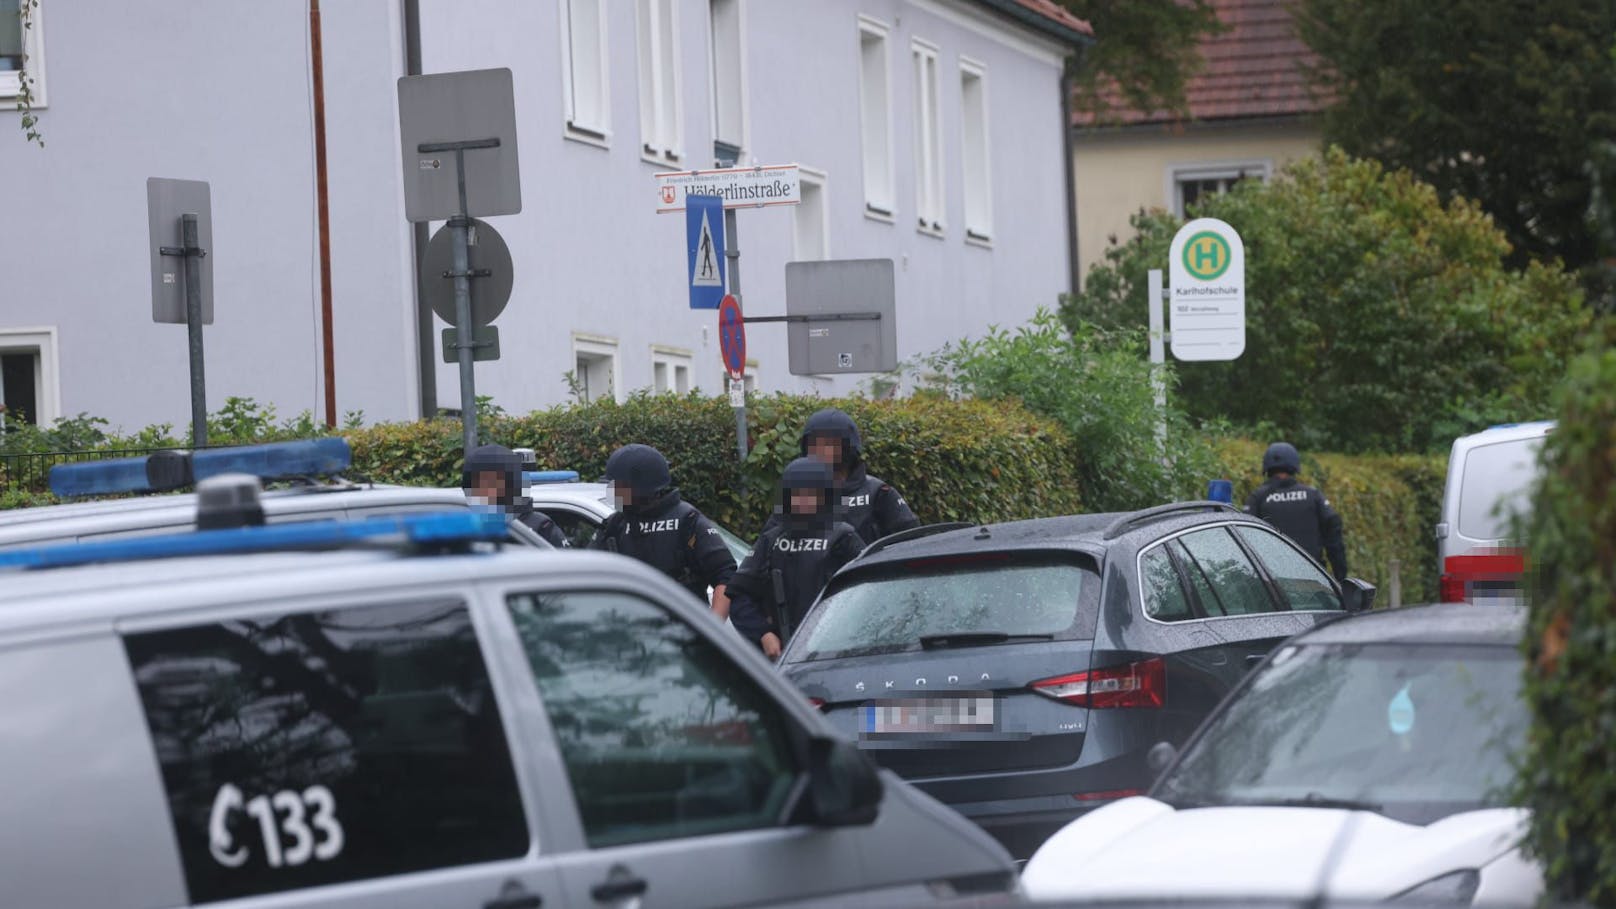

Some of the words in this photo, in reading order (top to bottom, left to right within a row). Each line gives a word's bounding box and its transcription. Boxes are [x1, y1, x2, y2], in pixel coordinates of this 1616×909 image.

[684, 180, 791, 201] Hölderlinstraße
[1176, 286, 1239, 296] Karlhofschule
[1266, 490, 1307, 503] POLIZEI
[772, 537, 828, 553] POLIZEI
[246, 784, 345, 868] 133
